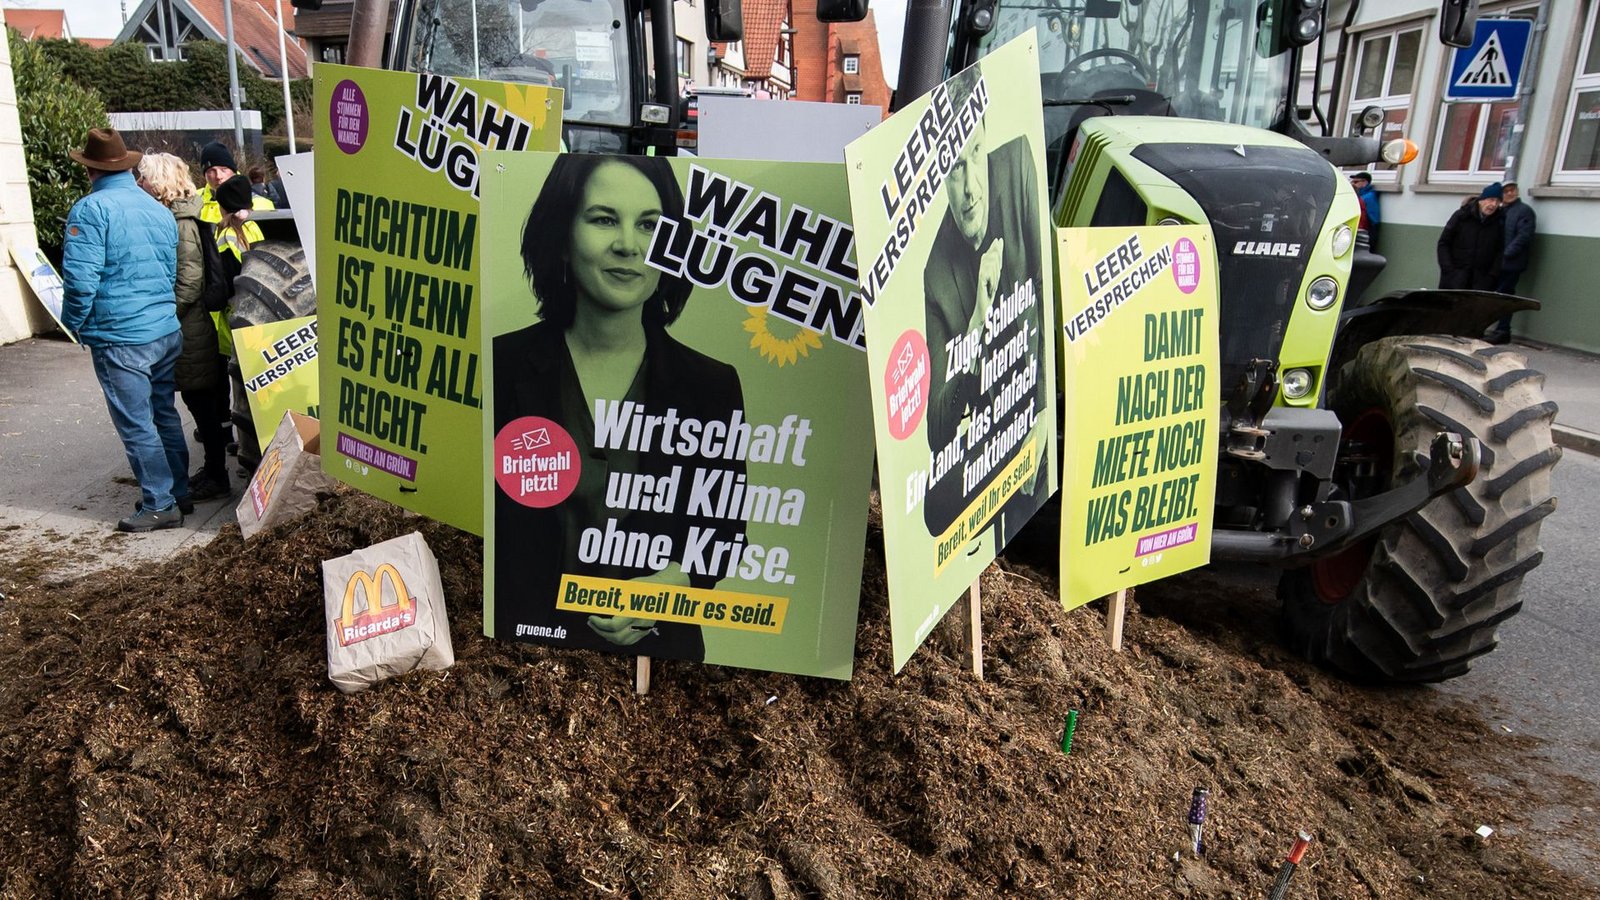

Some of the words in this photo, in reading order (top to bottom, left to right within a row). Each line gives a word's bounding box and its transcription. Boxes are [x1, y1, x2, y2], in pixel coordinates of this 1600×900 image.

[336, 101, 362, 117] STIMMEN
[342, 87, 356, 102] ALLE
[396, 110, 481, 197] LÜG
[881, 83, 952, 220] LEERE
[687, 168, 859, 281] WAHL
[861, 79, 988, 306] VERSPRECHEN!
[335, 188, 477, 271] REICHTUM
[1233, 241, 1301, 257] CLAAS
[335, 253, 375, 320] IST,
[385, 266, 473, 339] WENN
[648, 220, 867, 348] LÜGEN
[1064, 245, 1172, 342] VERSPRECHEN!
[1084, 234, 1143, 296] LEERE
[337, 316, 366, 372] ES
[369, 323, 423, 391] FÜR
[425, 344, 483, 410] ALL
[945, 328, 983, 383] Züge,
[984, 278, 1036, 346] Schulen,
[980, 319, 1028, 396] Internet
[1143, 308, 1204, 362] DAMIT
[338, 376, 428, 455] REICHT.
[889, 353, 926, 418] Briefwahl
[1115, 369, 1169, 426] NACH
[1171, 364, 1206, 415] DER
[341, 435, 357, 456] VON
[356, 442, 374, 463] HIER
[373, 450, 386, 468] AN
[386, 456, 411, 478] GRÜN.
[503, 451, 571, 475] Briefwahl
[593, 398, 812, 467] Wirtschaft
[906, 468, 927, 516] Ein
[928, 424, 965, 490] Land,
[967, 405, 992, 450] das
[993, 353, 1037, 423] einfach
[962, 397, 1037, 498] funktioniert.
[1091, 429, 1155, 489] MIETE
[1152, 419, 1206, 475] NOCH
[520, 472, 558, 497] jetzt!
[605, 466, 682, 513] und
[686, 467, 806, 527] Klima
[937, 521, 967, 568] Bereit,
[968, 495, 987, 533] weil
[988, 486, 1001, 513] Ihr
[1001, 475, 1012, 499] es
[1013, 449, 1033, 488] seid.
[1085, 489, 1132, 547] WAS
[1131, 473, 1200, 533] BLEIBT.
[577, 518, 673, 571] ohne
[680, 526, 797, 585] Krise.
[343, 611, 411, 643] Ricarda's
[515, 622, 567, 639] gruene.de
[563, 581, 626, 613] Bereit,
[629, 591, 669, 614] weil
[671, 592, 701, 618] Ihr
[702, 602, 727, 621] es
[730, 604, 777, 627] seid.
